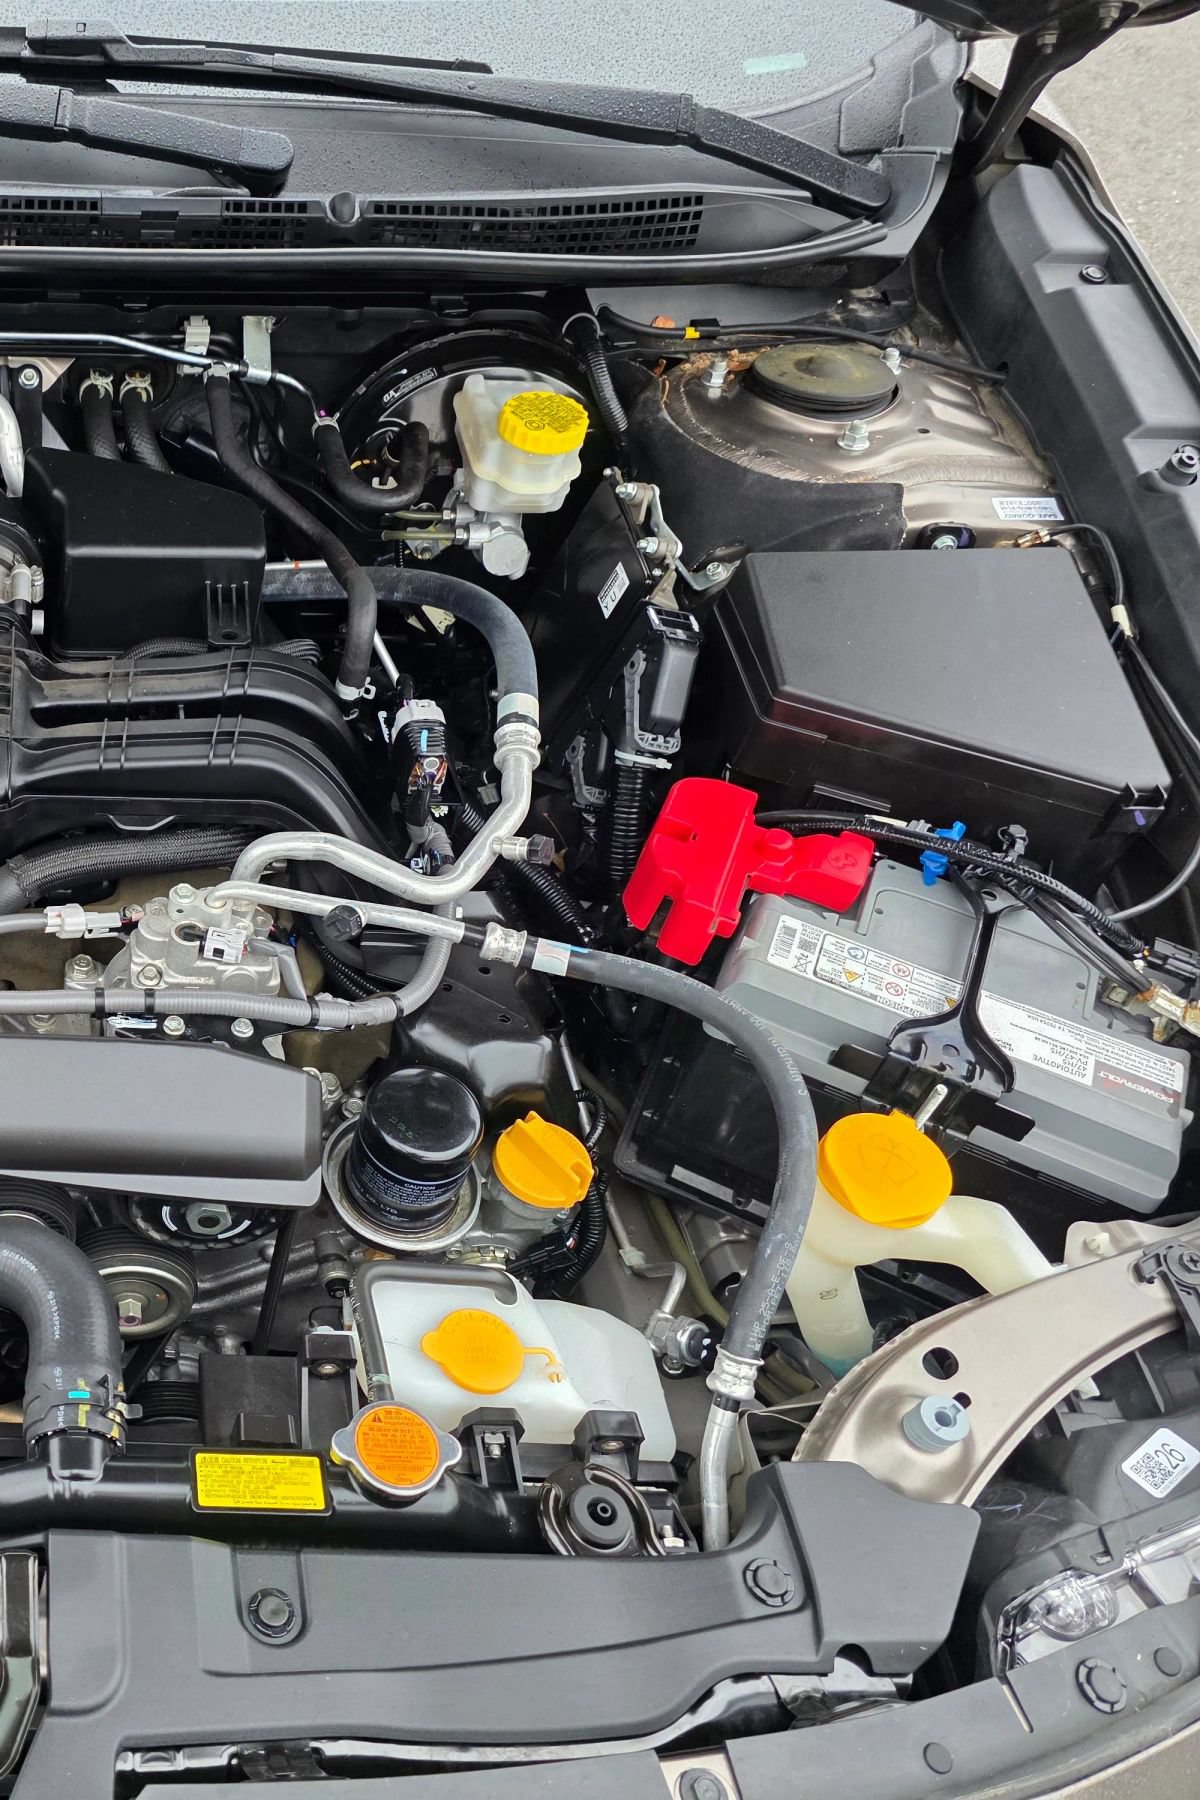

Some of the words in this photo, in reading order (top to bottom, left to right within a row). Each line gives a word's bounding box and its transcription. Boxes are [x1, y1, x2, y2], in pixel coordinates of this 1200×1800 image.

[1032, 1054, 1087, 1079] AUTOMOTIVE
[1098, 1071, 1174, 1104] POWERVOLT
[758, 1241, 792, 1317] 25-A-E-DE-S
[1155, 1443, 1186, 1470] 26
